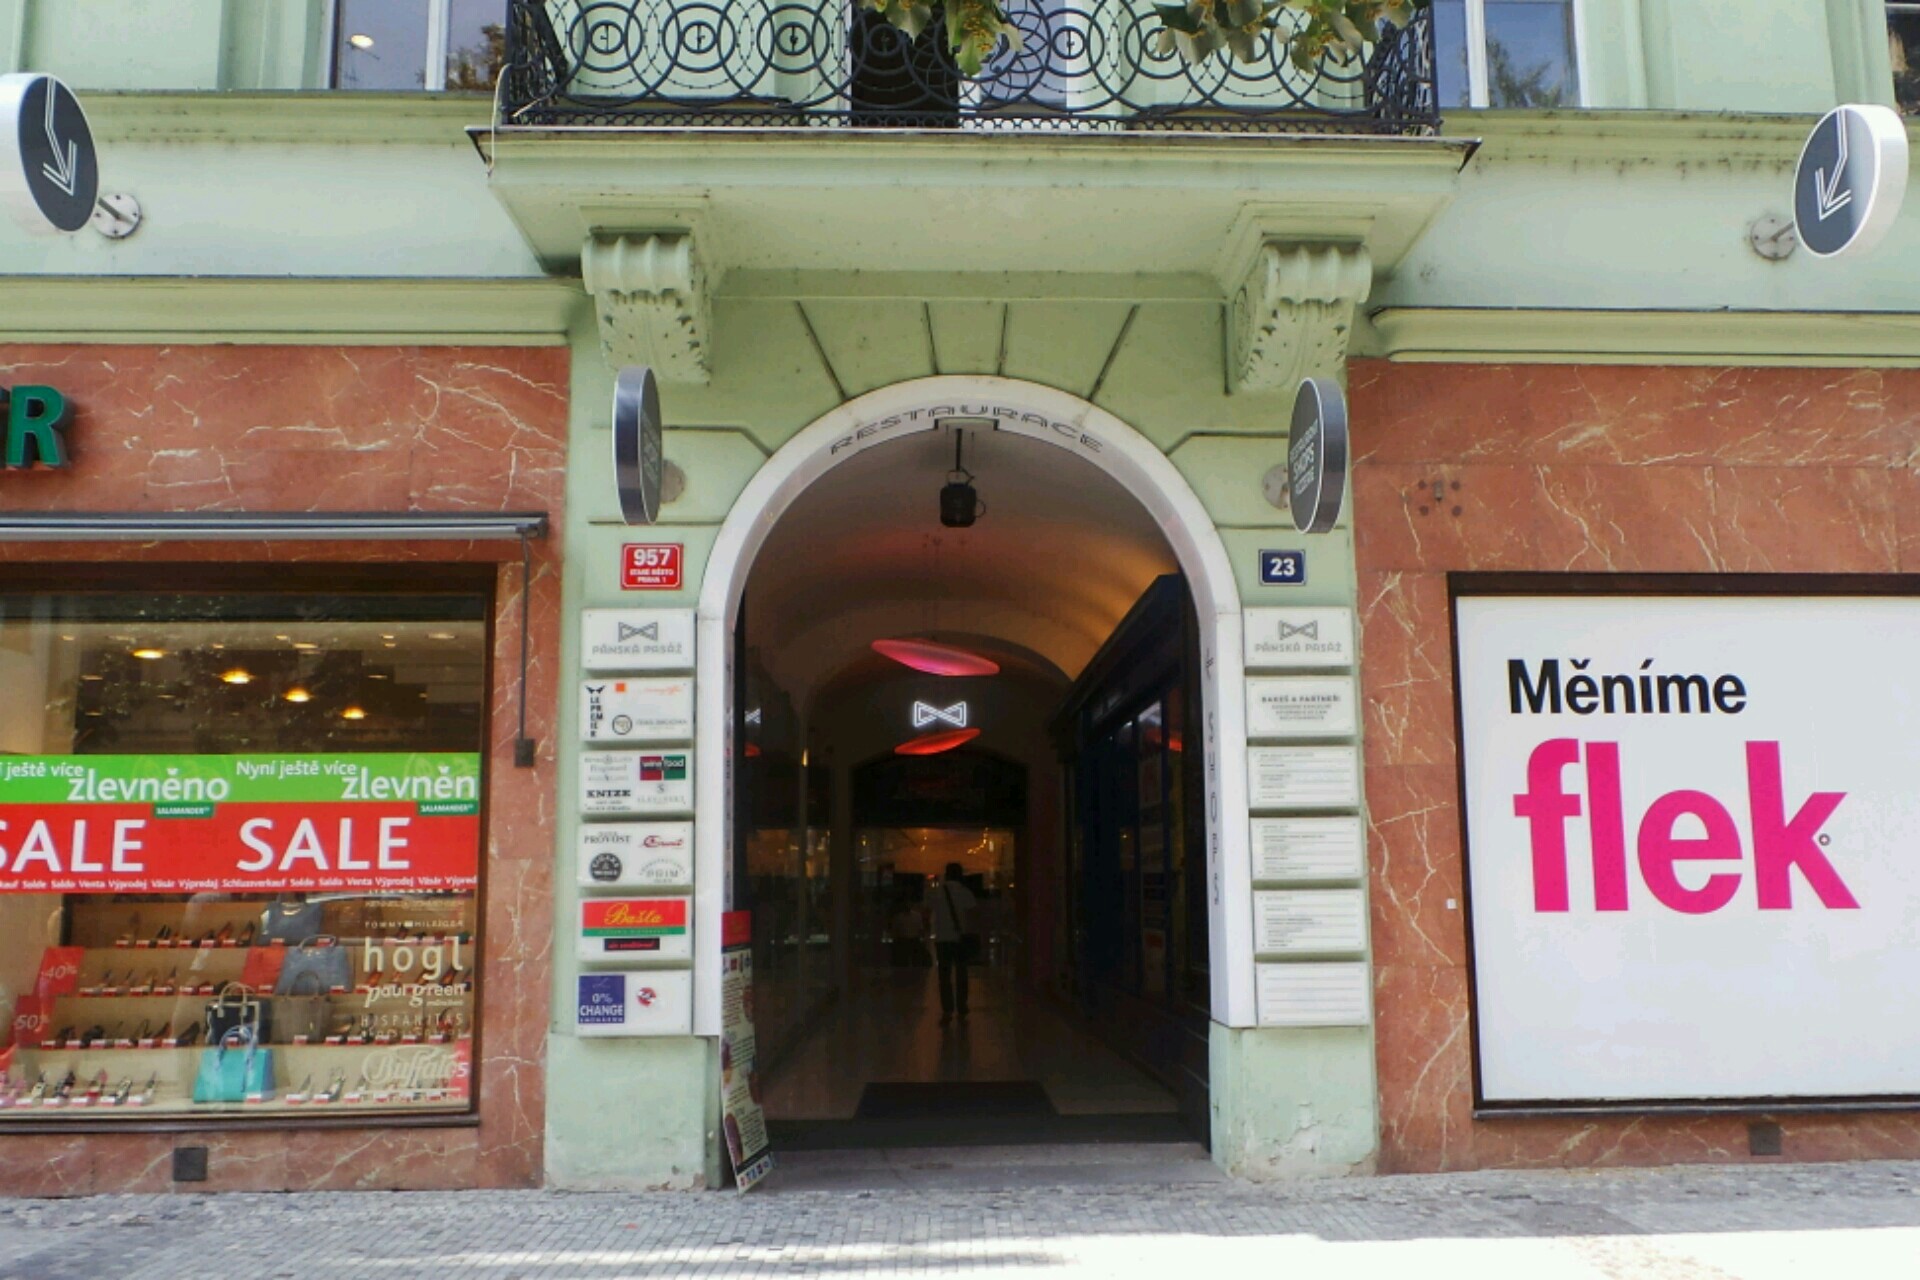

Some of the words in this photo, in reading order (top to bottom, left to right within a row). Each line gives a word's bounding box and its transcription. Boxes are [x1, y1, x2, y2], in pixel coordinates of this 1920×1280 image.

[7, 385, 64, 466] R
[831, 404, 1103, 455] RESTAURACE
[633, 548, 671, 566] 957
[1270, 557, 1296, 577] 23
[592, 643, 641, 655] PÁNSKÁ
[643, 642, 683, 655] PASÁŽ
[1254, 642, 1302, 653] PÁNSKÁ
[1305, 641, 1342, 653] PASÁŽ
[1507, 659, 1748, 714] Měníme
[4, 763, 47, 781] ještě
[50, 763, 84, 777] více
[236, 761, 275, 779] Nyní
[278, 760, 319, 779] ještě
[323, 761, 357, 775] více
[67, 768, 230, 801] zlevněno
[341, 765, 476, 800] zlevněn
[157, 807, 208, 815] SALAMANDER
[421, 804, 472, 813] SALAMANDER
[1513, 738, 1862, 915] flek
[0, 819, 147, 873] ALE
[236, 817, 411, 872] SALE
[592, 992, 613, 1004] 0%
[580, 1004, 624, 1017] CHANGE
